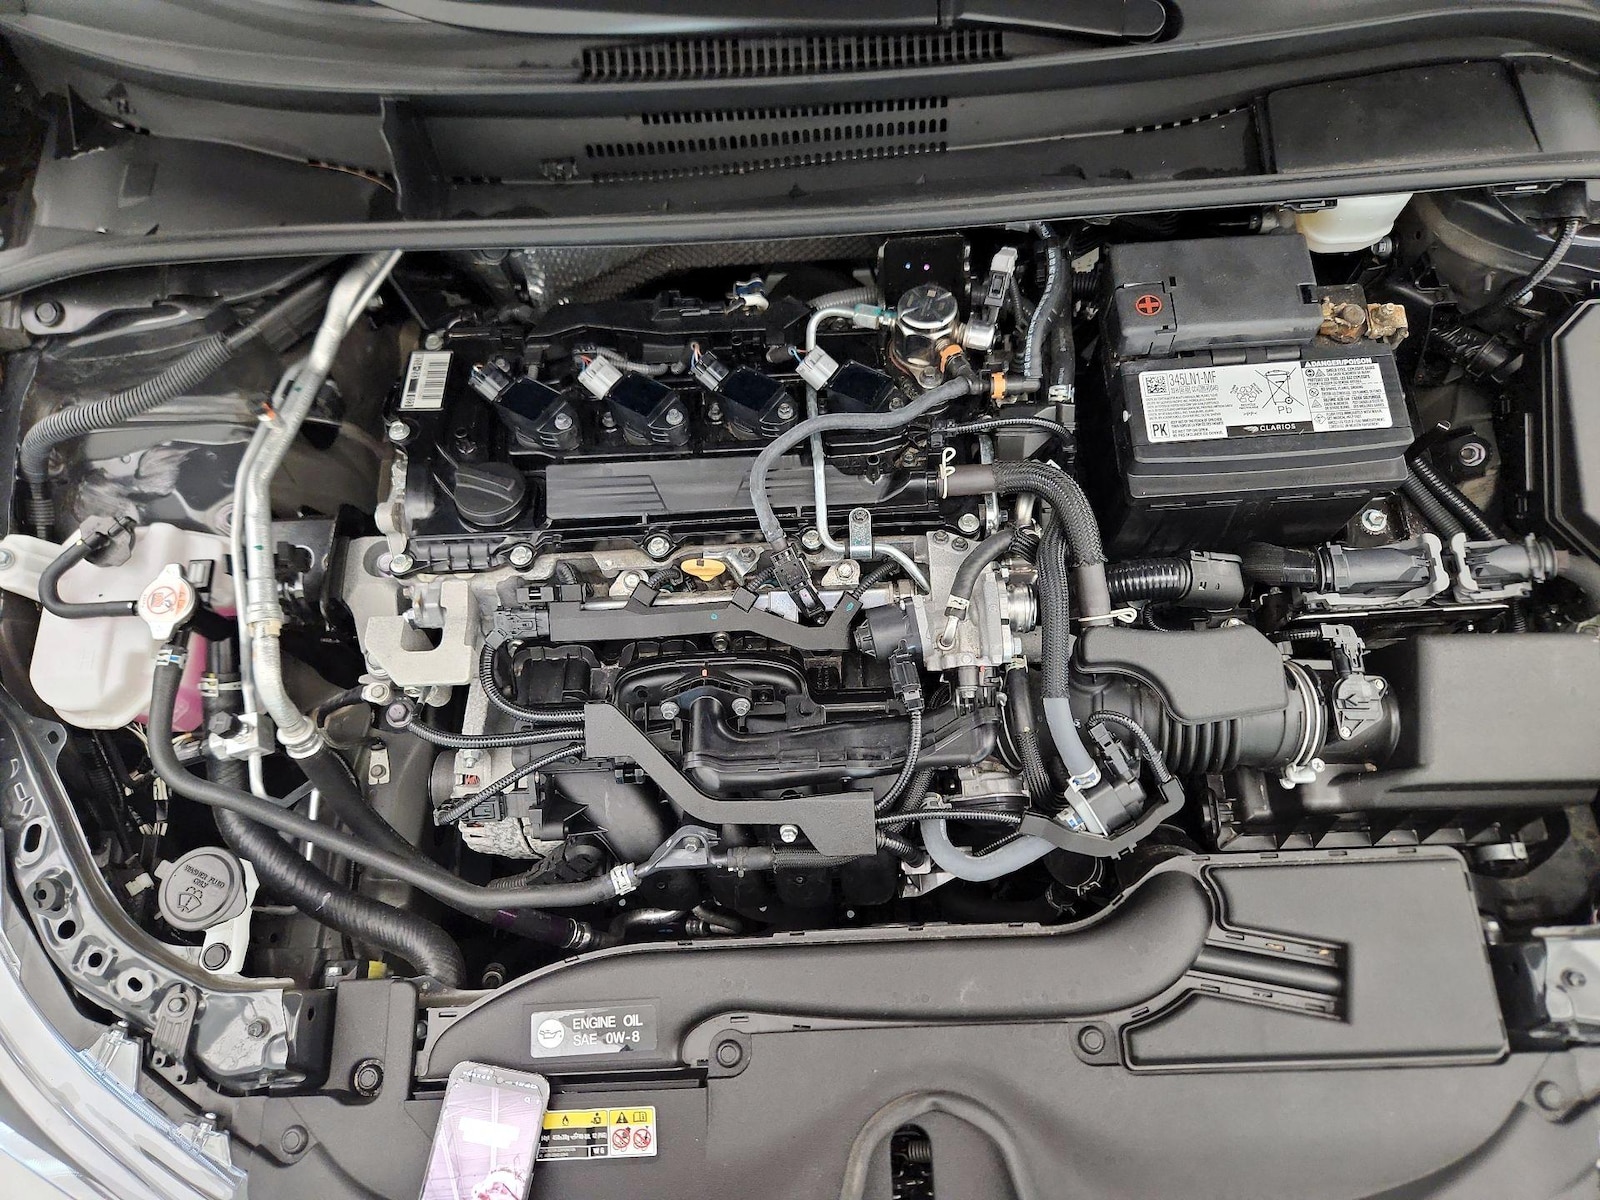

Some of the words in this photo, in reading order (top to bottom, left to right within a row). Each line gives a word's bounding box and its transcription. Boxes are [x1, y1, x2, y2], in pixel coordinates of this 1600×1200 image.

[1310, 358, 1372, 367] DANGER/POISON
[1169, 371, 1217, 386] 345LN1-MF
[1277, 405, 1293, 415] Pb
[1152, 423, 1168, 437] PK
[1259, 423, 1296, 432] CLARIOS
[184, 864, 208, 879] WASHER
[572, 1015, 616, 1030] ENGINE
[623, 1014, 643, 1027] OIL
[572, 1032, 598, 1046] SAE
[605, 1031, 641, 1045] 0W-8
